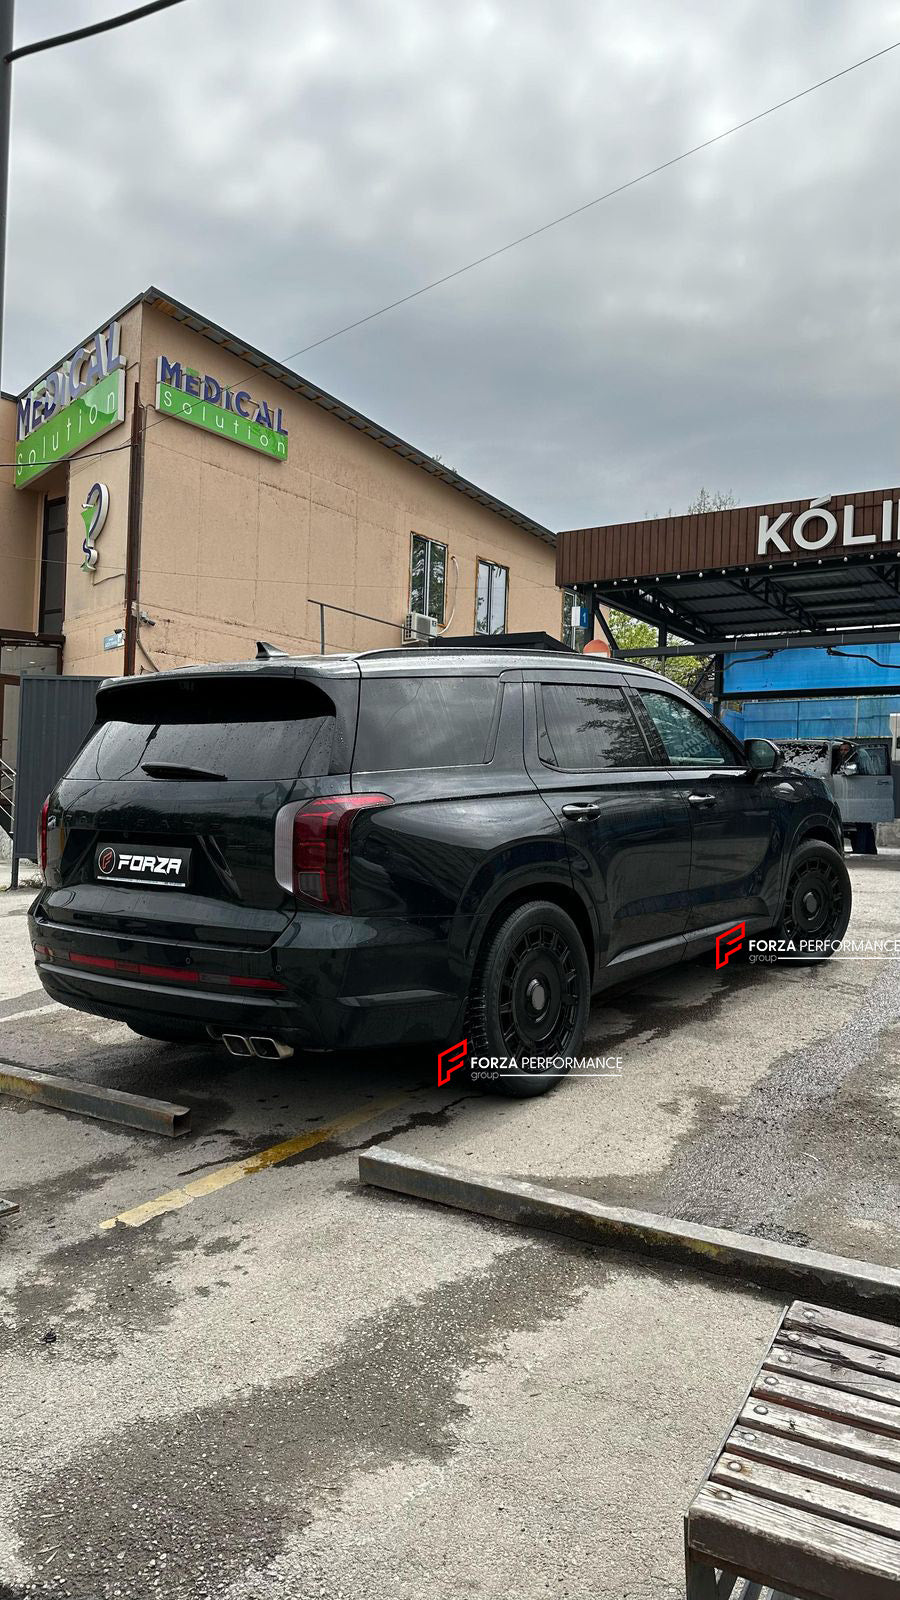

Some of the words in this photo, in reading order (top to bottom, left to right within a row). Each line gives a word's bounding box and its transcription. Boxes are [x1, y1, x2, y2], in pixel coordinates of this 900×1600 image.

[17, 321, 126, 441] MEDICAL
[157, 355, 288, 435] MEDICAL
[17, 391, 116, 476] Solution
[163, 390, 285, 454] Solution
[757, 493, 900, 555] KÓLI
[118, 854, 182, 875] FORZA
